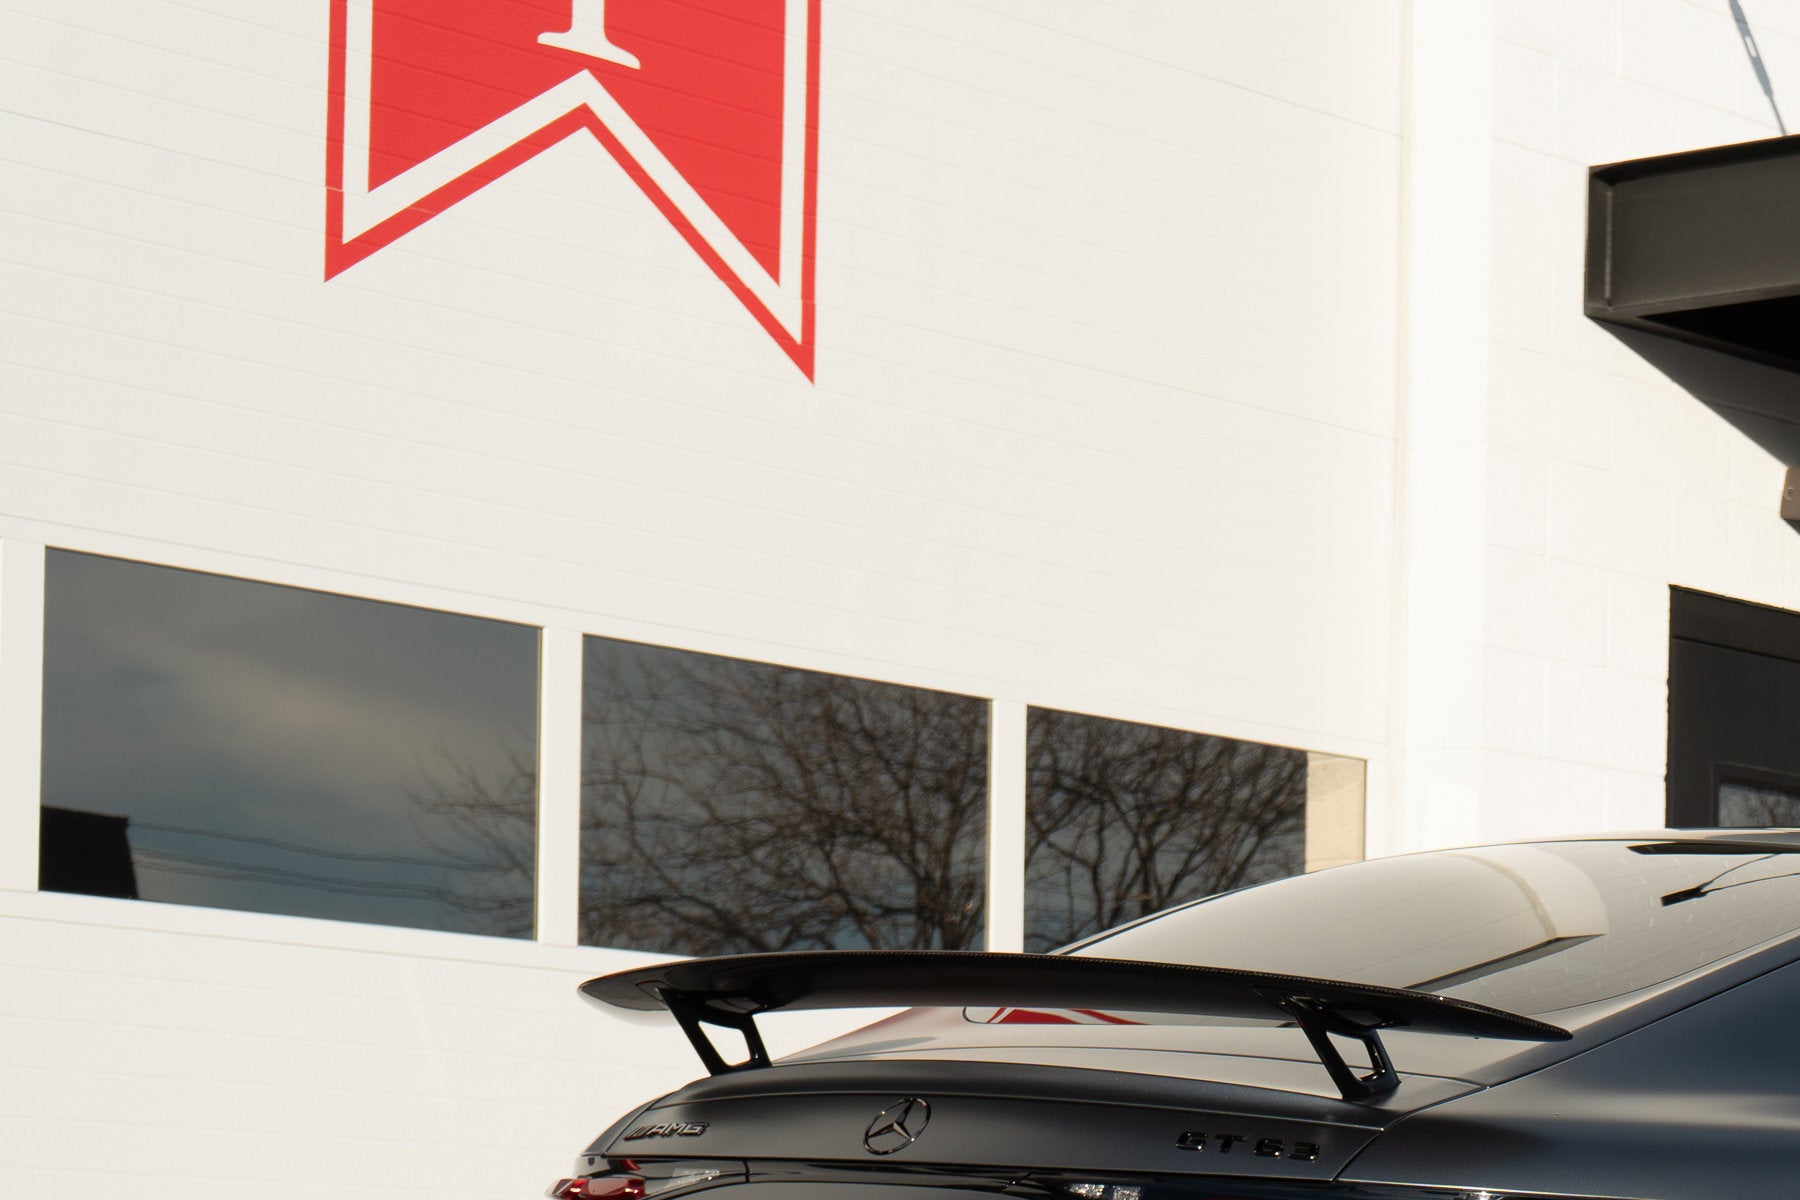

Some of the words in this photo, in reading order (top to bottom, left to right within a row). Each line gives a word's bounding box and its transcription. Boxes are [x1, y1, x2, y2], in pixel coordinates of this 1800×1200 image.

[646, 1121, 709, 1138] AMG
[1176, 1130, 1249, 1154] GT
[1252, 1138, 1321, 1162] 63
